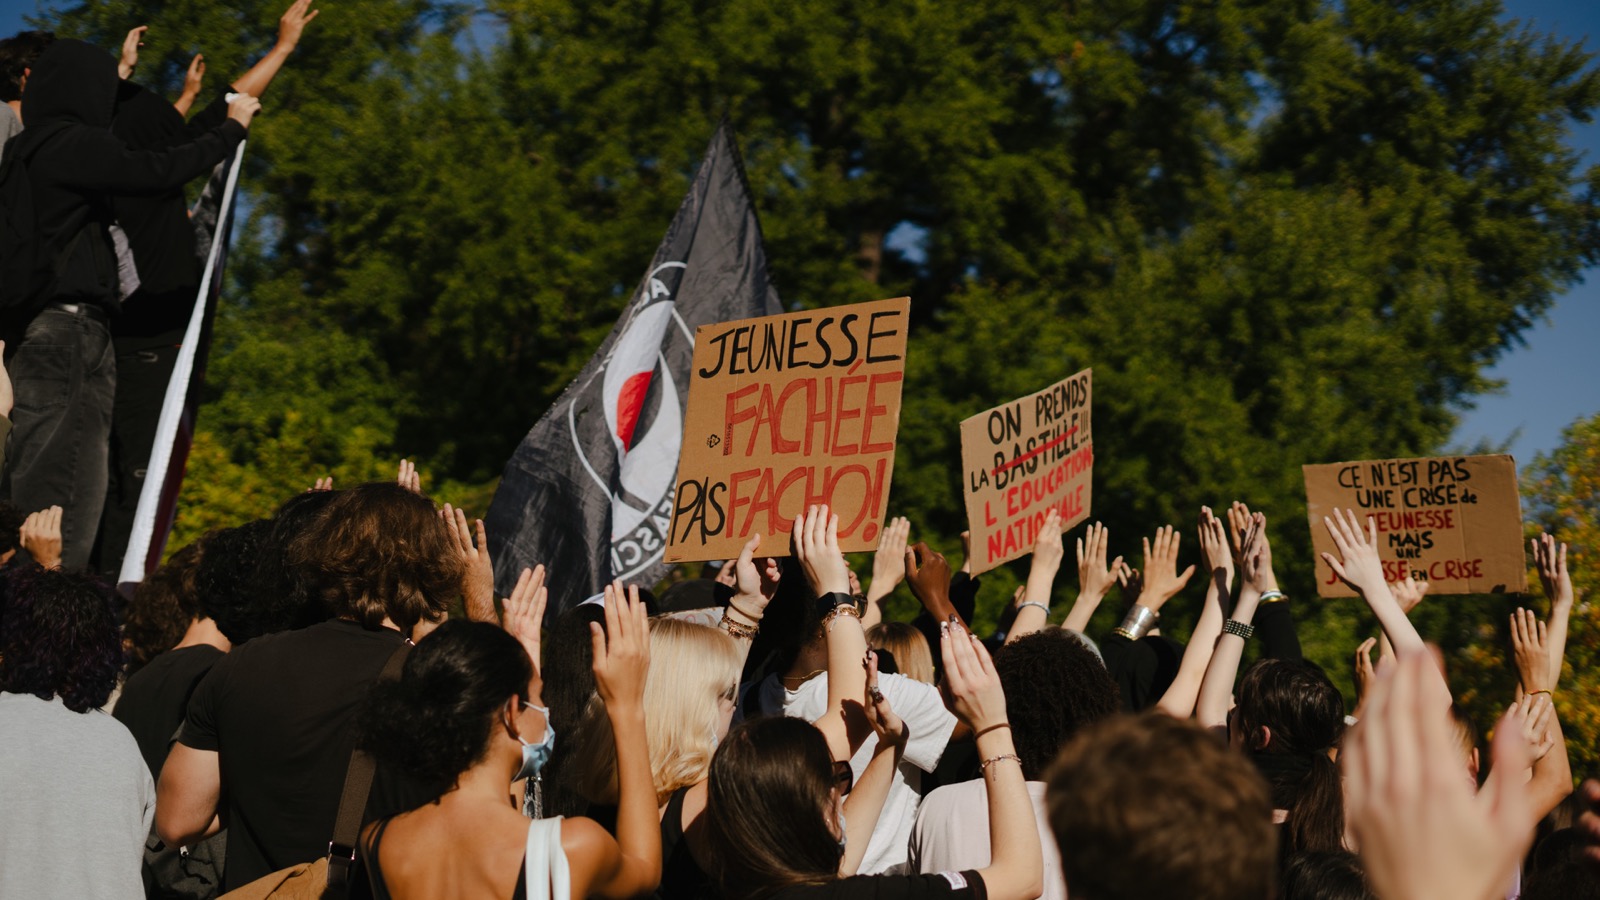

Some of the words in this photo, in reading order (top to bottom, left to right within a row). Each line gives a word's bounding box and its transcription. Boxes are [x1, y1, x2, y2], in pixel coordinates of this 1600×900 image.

[699, 310, 902, 379] JEUNESSE
[723, 358, 903, 457] FACHÉE
[987, 403, 1022, 445] ON
[1035, 375, 1088, 428] PRENDS
[970, 468, 990, 493] LA
[1337, 465, 1363, 488] CE
[1371, 461, 1420, 487] N'EST
[1428, 458, 1471, 485] PAS
[669, 476, 728, 546] PAS
[725, 458, 888, 543] FACHO!
[1356, 489, 1396, 508] UNE
[1403, 484, 1459, 507] CRISE
[1460, 488, 1478, 504] de
[987, 484, 1085, 564] NATIOALE
[1388, 530, 1434, 550] MAIS
[1395, 547, 1421, 559] UNE
[1411, 570, 1429, 582] EN
[1429, 558, 1484, 581] CRISE
